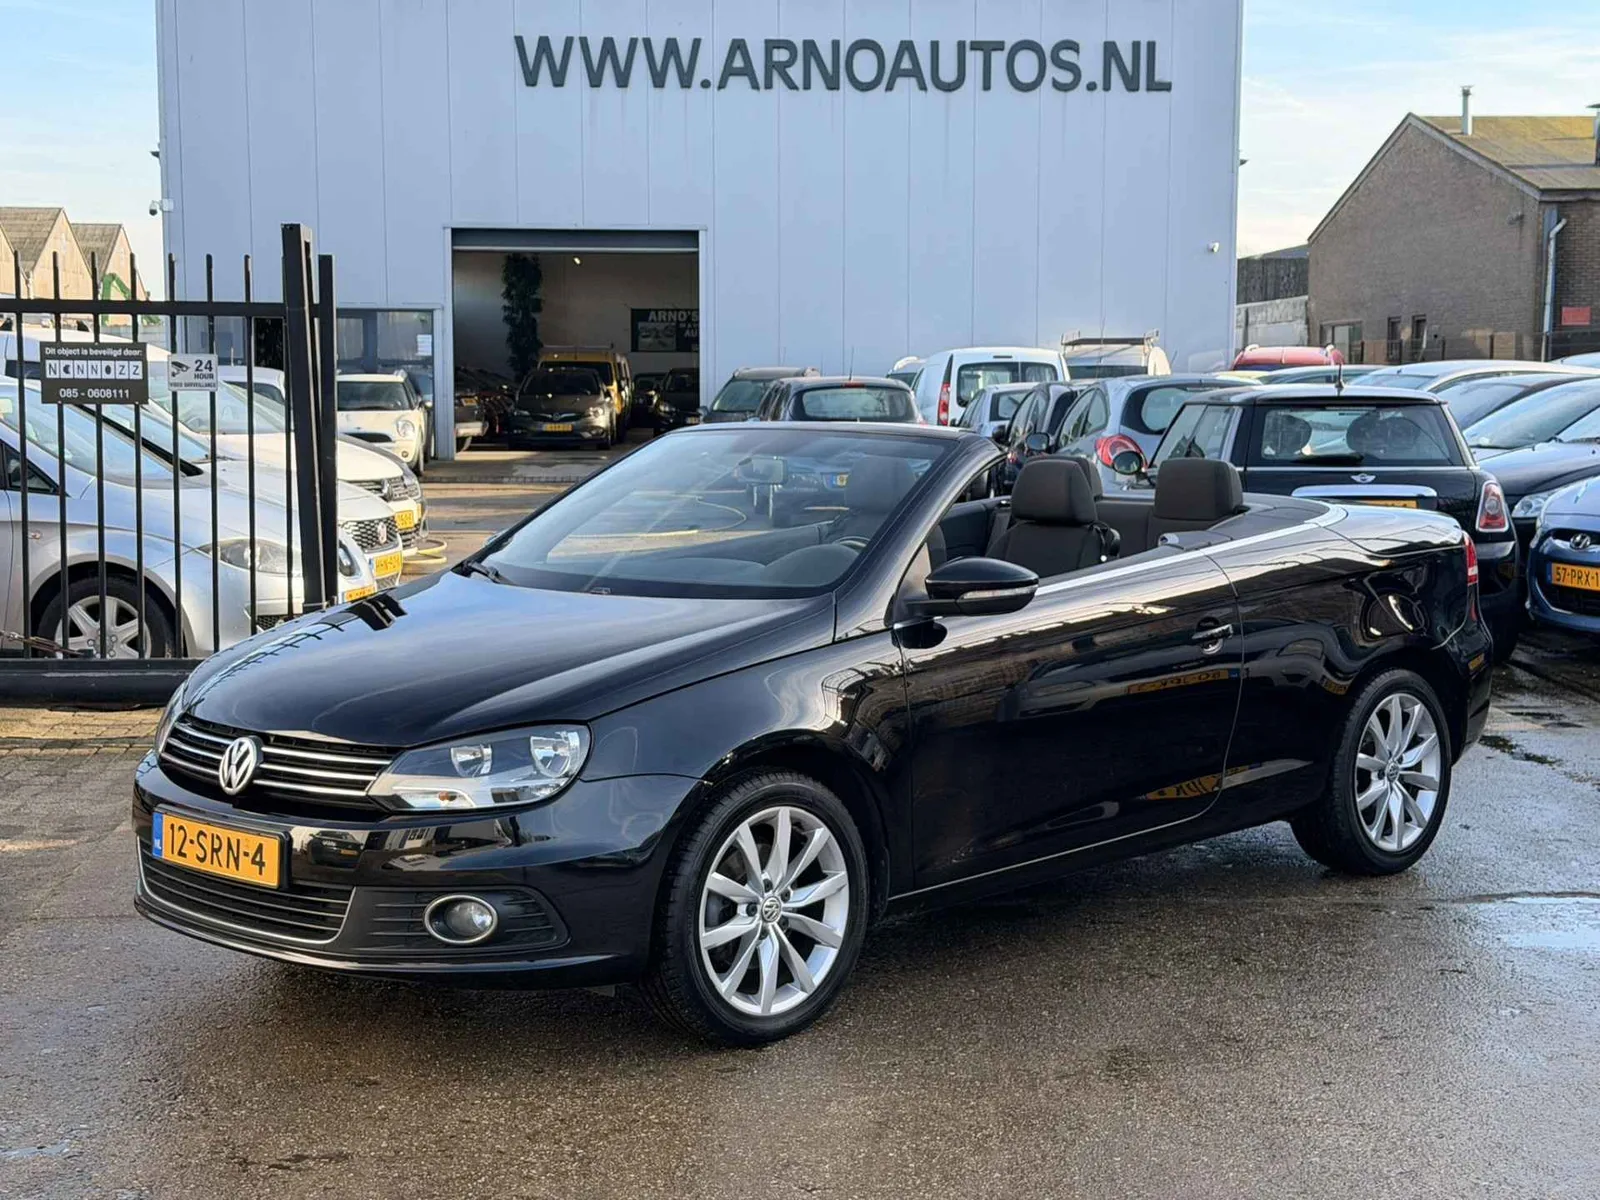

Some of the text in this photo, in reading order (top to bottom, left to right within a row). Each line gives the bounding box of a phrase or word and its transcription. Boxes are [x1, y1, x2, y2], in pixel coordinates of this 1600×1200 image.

[514, 36, 1172, 92] WWW.ARNOAUTOS.NL
[45, 347, 56, 355] Dit
[57, 347, 80, 356] object
[89, 348, 122, 357] beveiligd
[194, 359, 213, 372] 24
[59, 388, 79, 398] 085
[87, 388, 130, 399] 0608111
[1555, 566, 1599, 588] 57-PRX-1
[170, 822, 266, 876] 12-SRN-4
